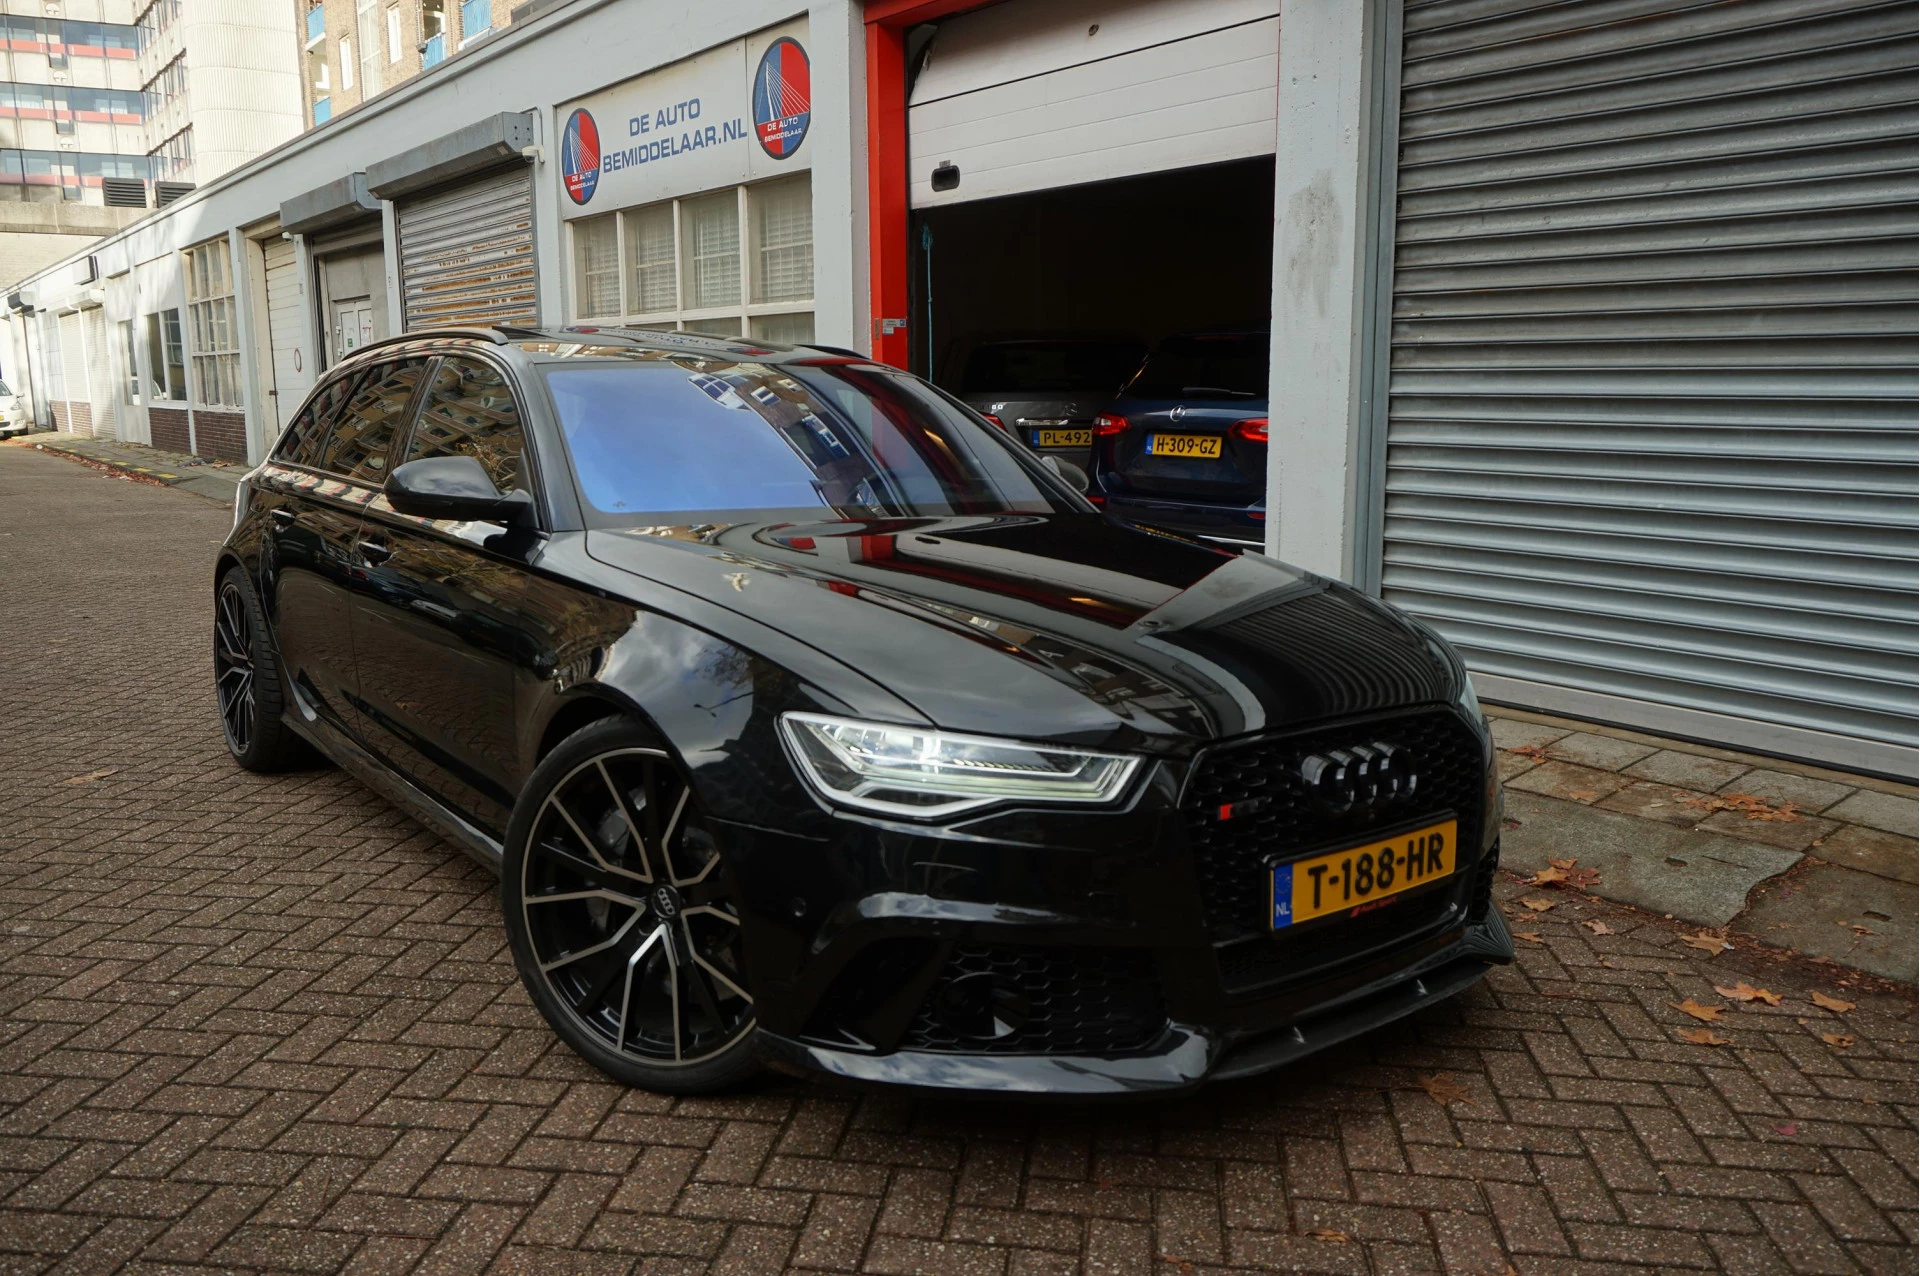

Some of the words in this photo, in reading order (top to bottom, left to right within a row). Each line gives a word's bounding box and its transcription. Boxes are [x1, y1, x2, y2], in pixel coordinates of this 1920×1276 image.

[629, 113, 650, 137] DE
[655, 98, 701, 130] AUTO
[767, 122, 777, 132] DE
[779, 116, 798, 129] AUTO
[764, 127, 802, 142] BEMIDDELAAR
[603, 118, 748, 174] BEMIDDELAAR.NL
[571, 174, 579, 183] DE
[579, 171, 592, 180] AUTO
[1043, 431, 1091, 445] PL-492
[1156, 436, 1218, 455] H-309-GZ
[1275, 902, 1291, 917] NL
[1308, 832, 1444, 910] T-188-HR
